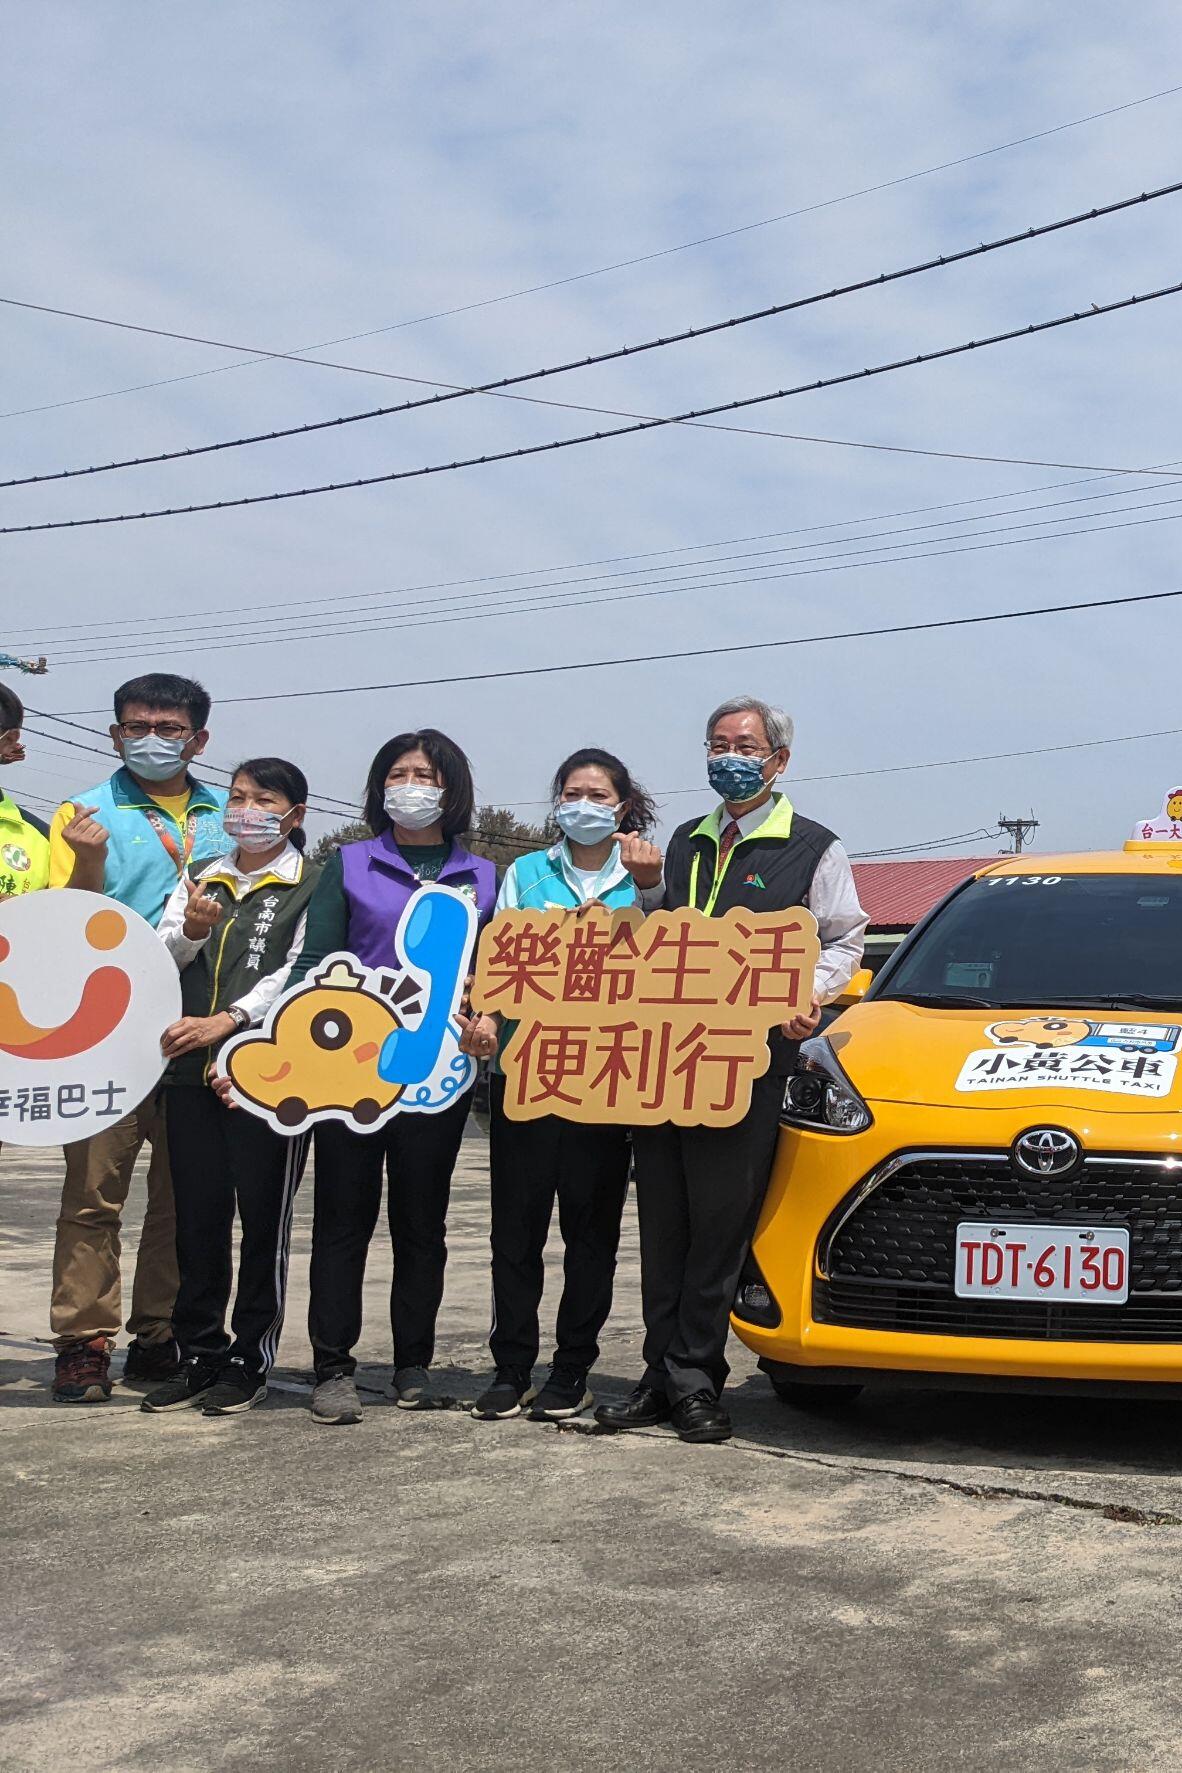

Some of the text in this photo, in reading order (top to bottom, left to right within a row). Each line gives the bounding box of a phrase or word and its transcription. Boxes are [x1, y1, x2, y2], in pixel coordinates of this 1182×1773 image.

[988, 876, 1062, 886] 1130
[245, 895, 279, 970] 台南市議員
[483, 921, 806, 1007] 樂齡生活
[514, 1020, 754, 1111] 便利行
[966, 1075, 1161, 1091] TAINAN SHUTTLE TAXI
[971, 1051, 1164, 1079] 小黃公車
